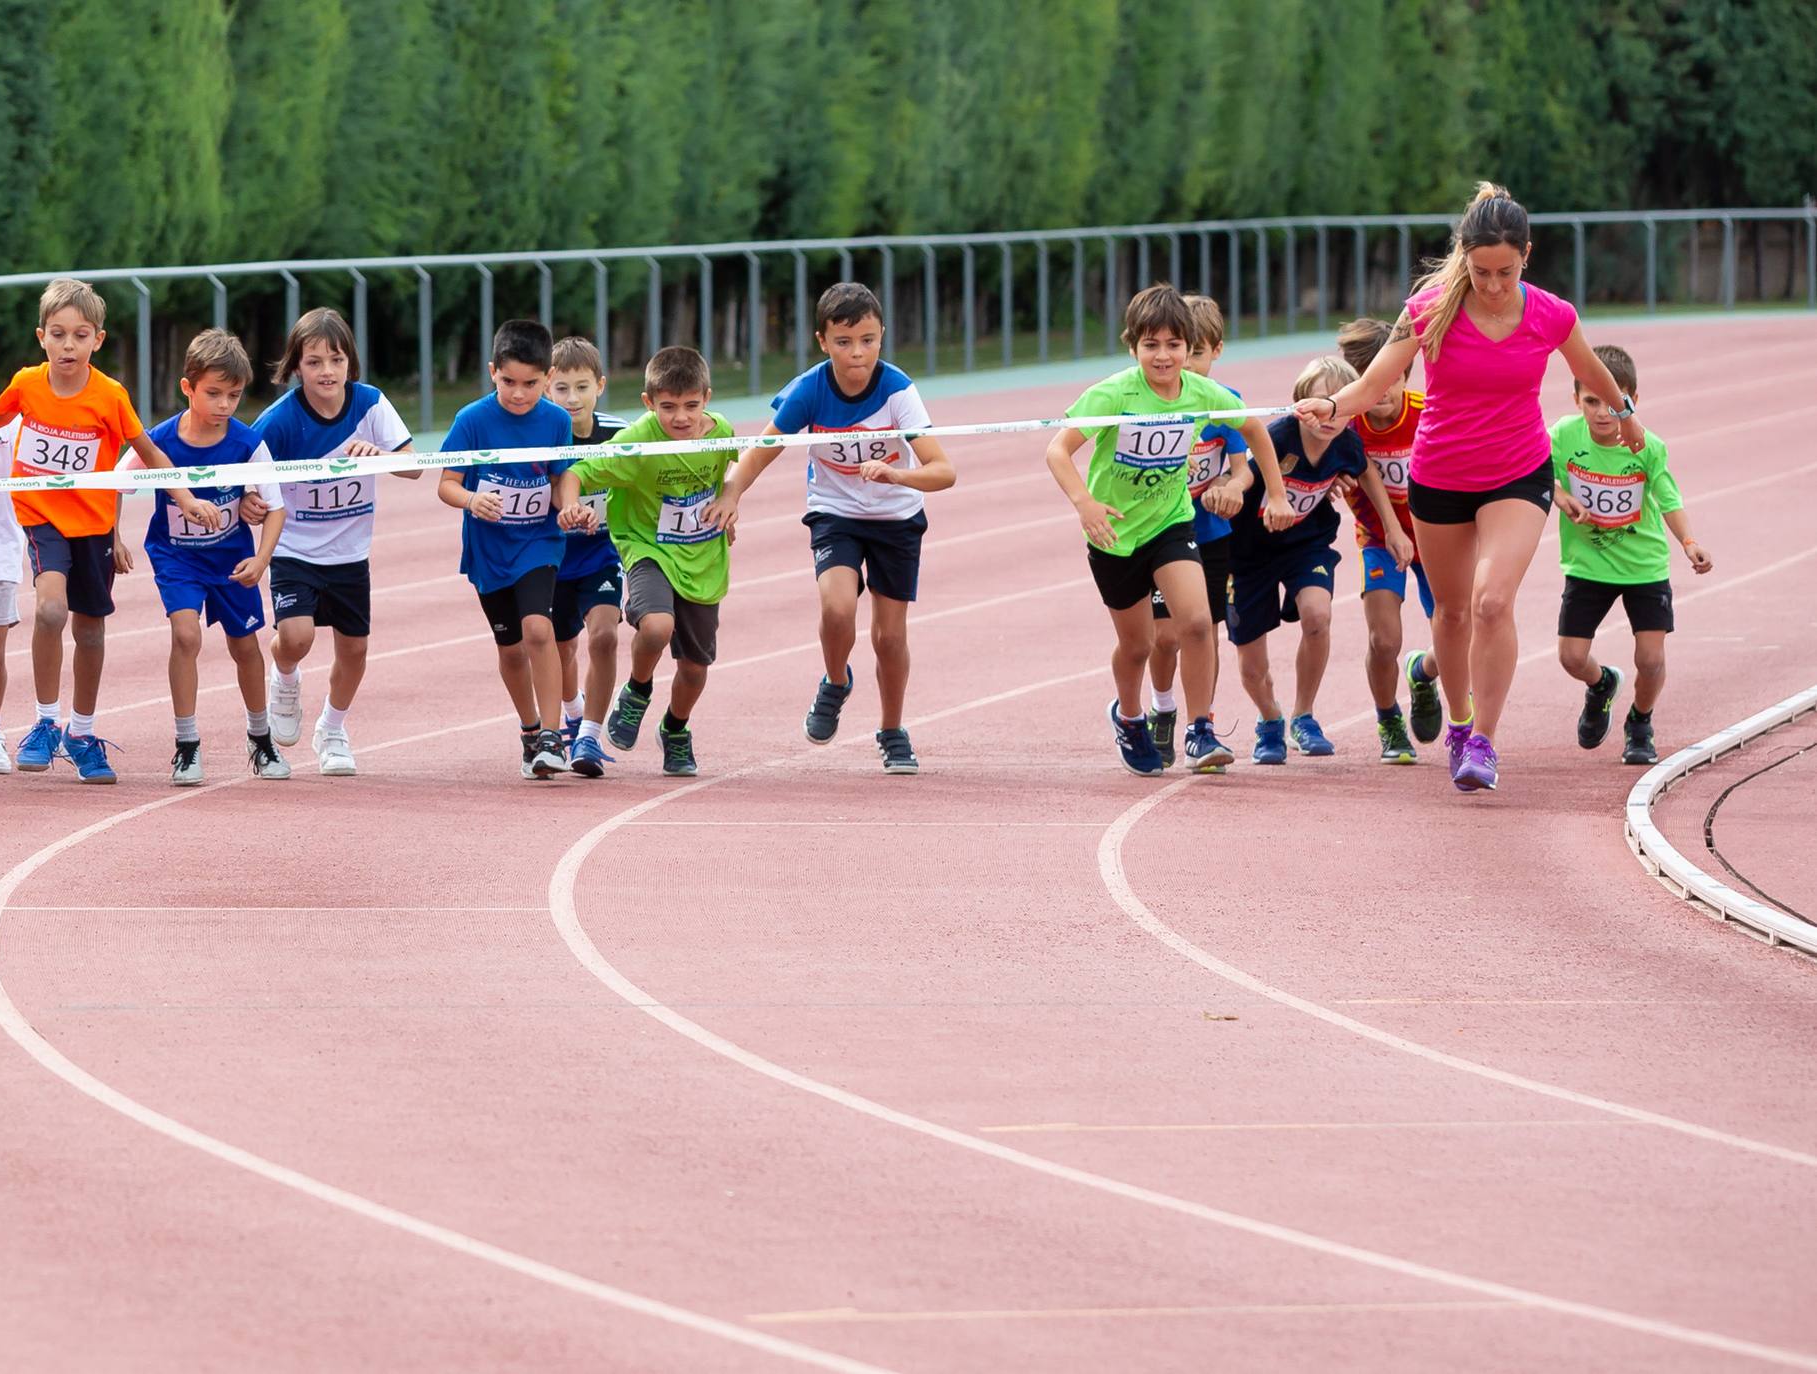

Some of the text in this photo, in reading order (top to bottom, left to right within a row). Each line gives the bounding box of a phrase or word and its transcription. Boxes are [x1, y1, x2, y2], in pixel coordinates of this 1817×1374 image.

[30, 421, 97, 440] LA RIOJA ATLETISMO
[830, 442, 887, 464] 318
[1128, 430, 1185, 456] 107
[32, 438, 89, 471] 348
[417, 456, 465, 465] Gobierno
[133, 471, 182, 480] Gobierno
[275, 463, 323, 472] Gobierno
[213, 492, 236, 506] AFIX
[308, 481, 363, 510] 112
[1580, 485, 1633, 513] 368
[670, 502, 710, 534] 11
